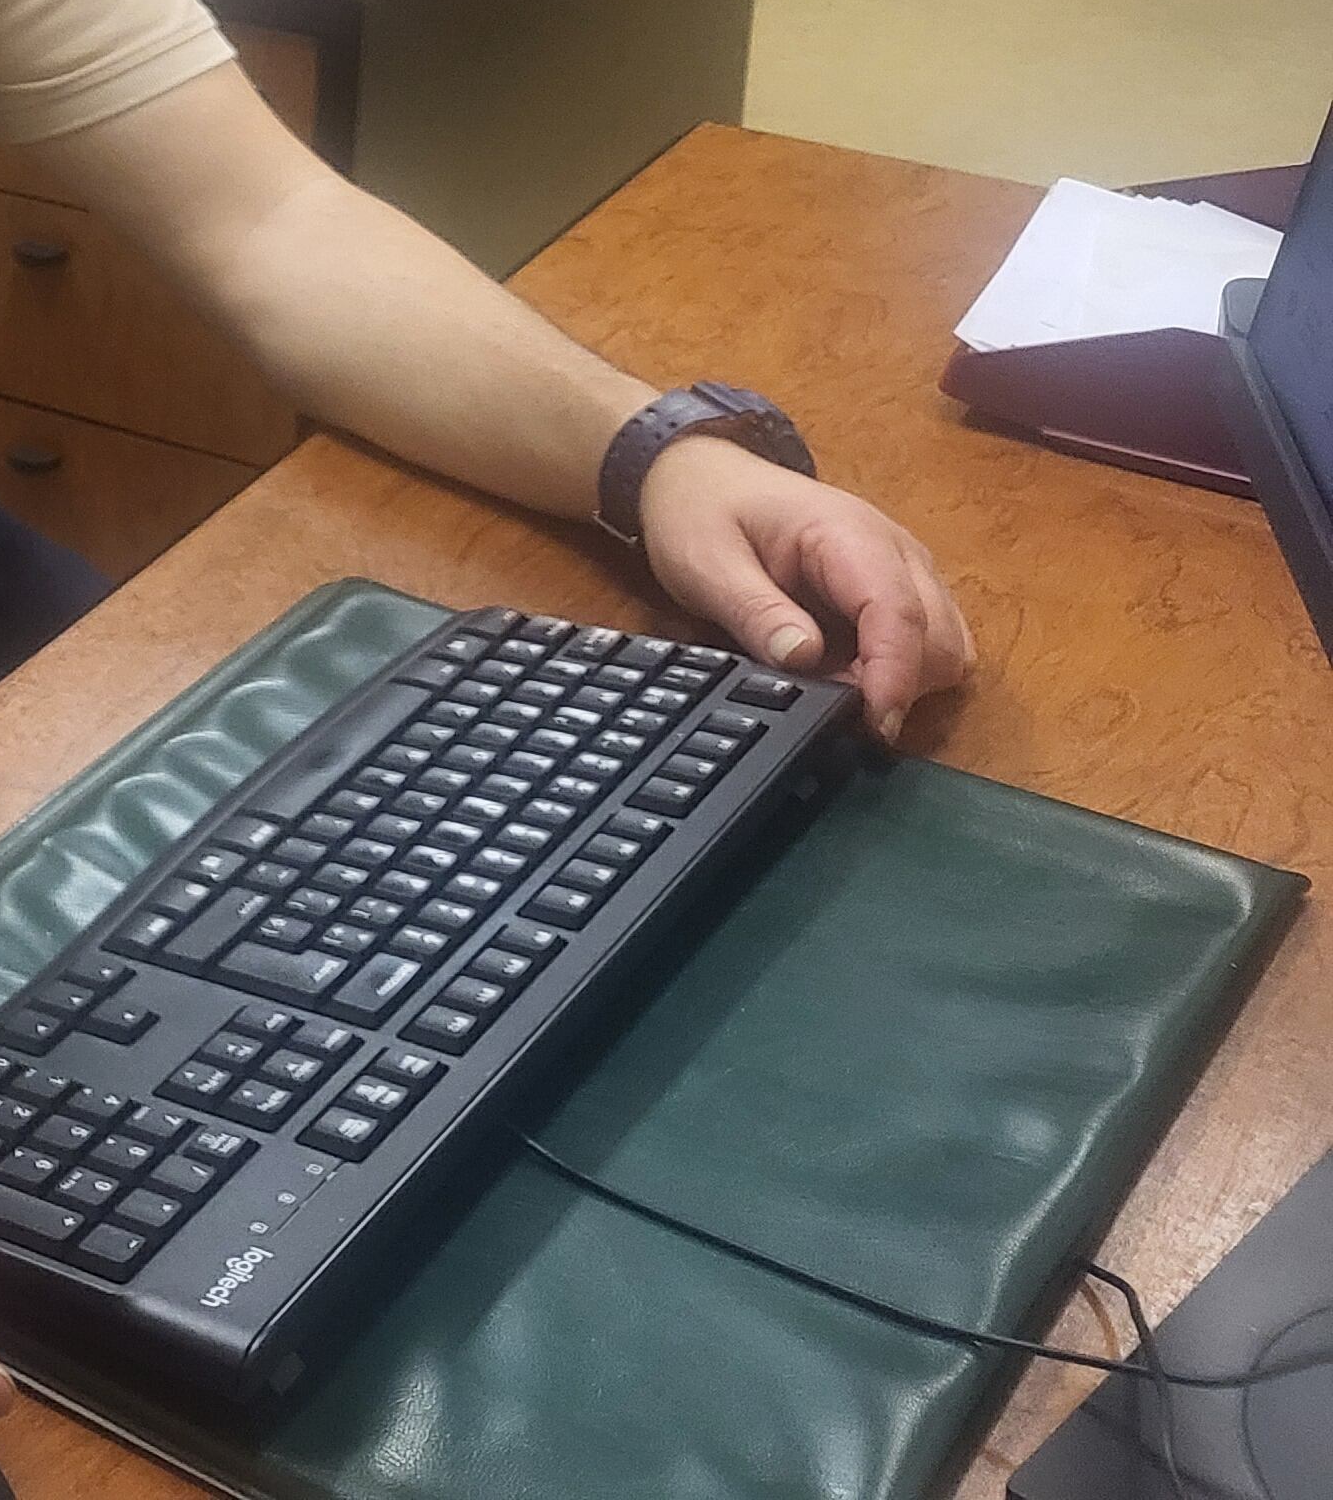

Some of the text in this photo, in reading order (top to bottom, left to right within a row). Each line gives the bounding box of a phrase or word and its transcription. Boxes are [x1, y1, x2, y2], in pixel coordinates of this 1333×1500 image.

[103, 1095, 121, 1106] 4
[13, 1106, 32, 1117] 2
[164, 1114, 183, 1127] 7
[70, 1126, 90, 1138] 5
[200, 1246, 274, 1307] logitech
